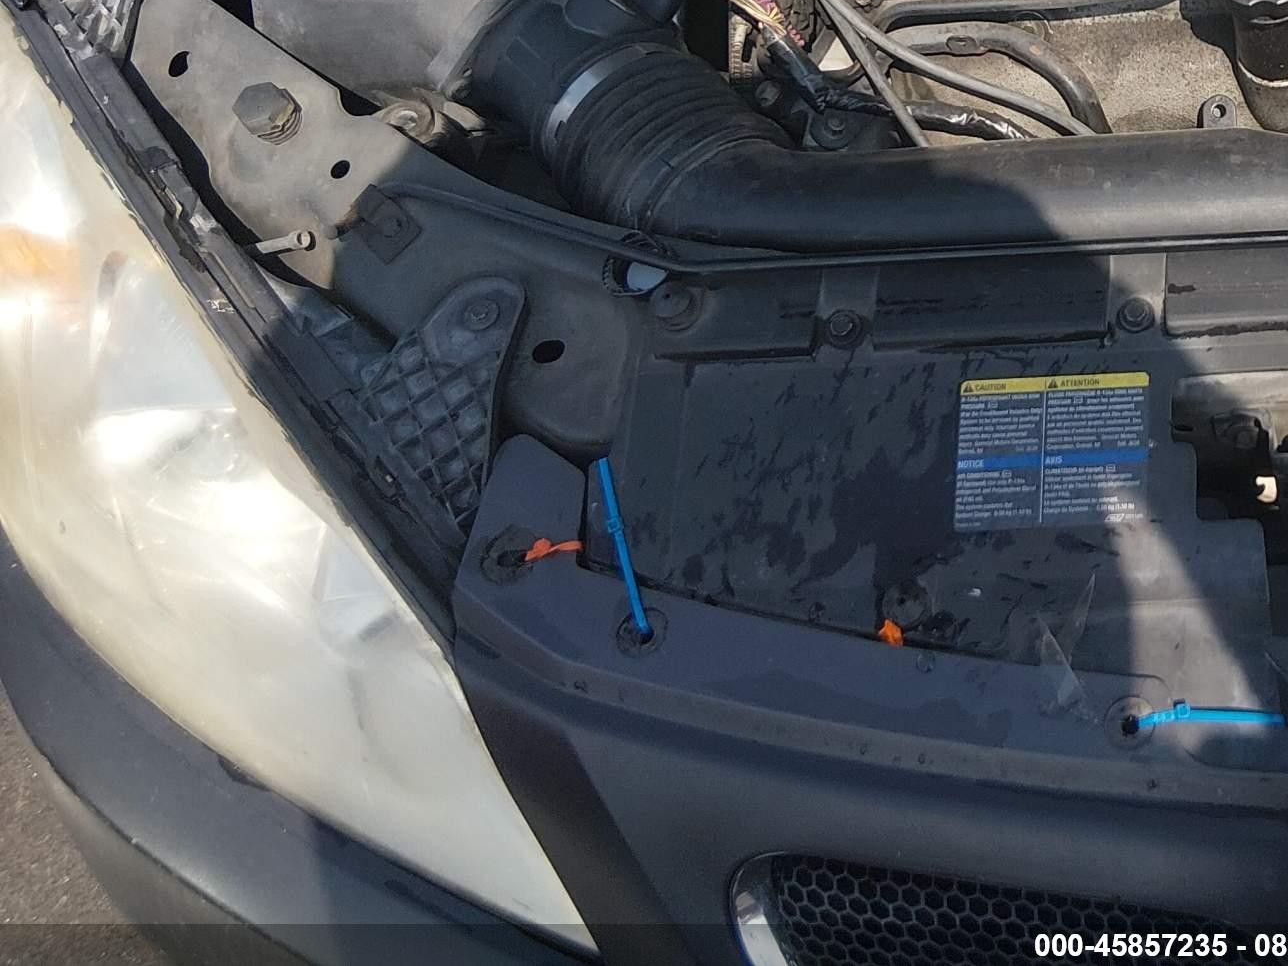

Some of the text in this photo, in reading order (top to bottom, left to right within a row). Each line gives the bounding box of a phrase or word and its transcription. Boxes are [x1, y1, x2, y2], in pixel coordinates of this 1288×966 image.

[1060, 378, 1100, 387] ATTENTION
[957, 458, 984, 468] NOTICE
[1045, 455, 1062, 464] AVIS
